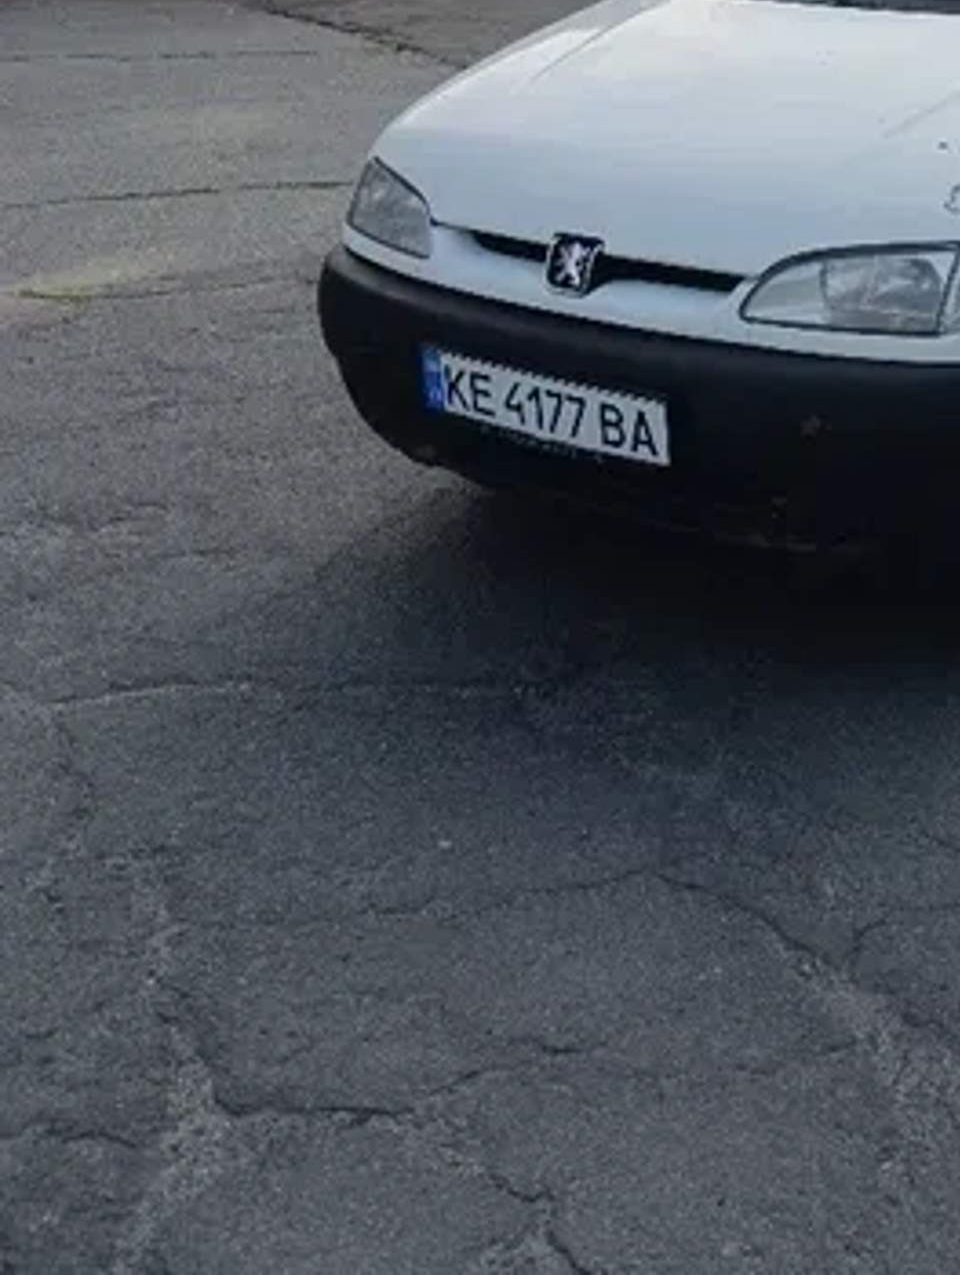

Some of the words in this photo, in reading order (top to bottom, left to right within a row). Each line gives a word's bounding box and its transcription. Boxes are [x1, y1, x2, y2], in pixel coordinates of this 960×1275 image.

[444, 363, 496, 418] KE
[504, 382, 587, 438] 4177
[600, 401, 659, 457] BA
